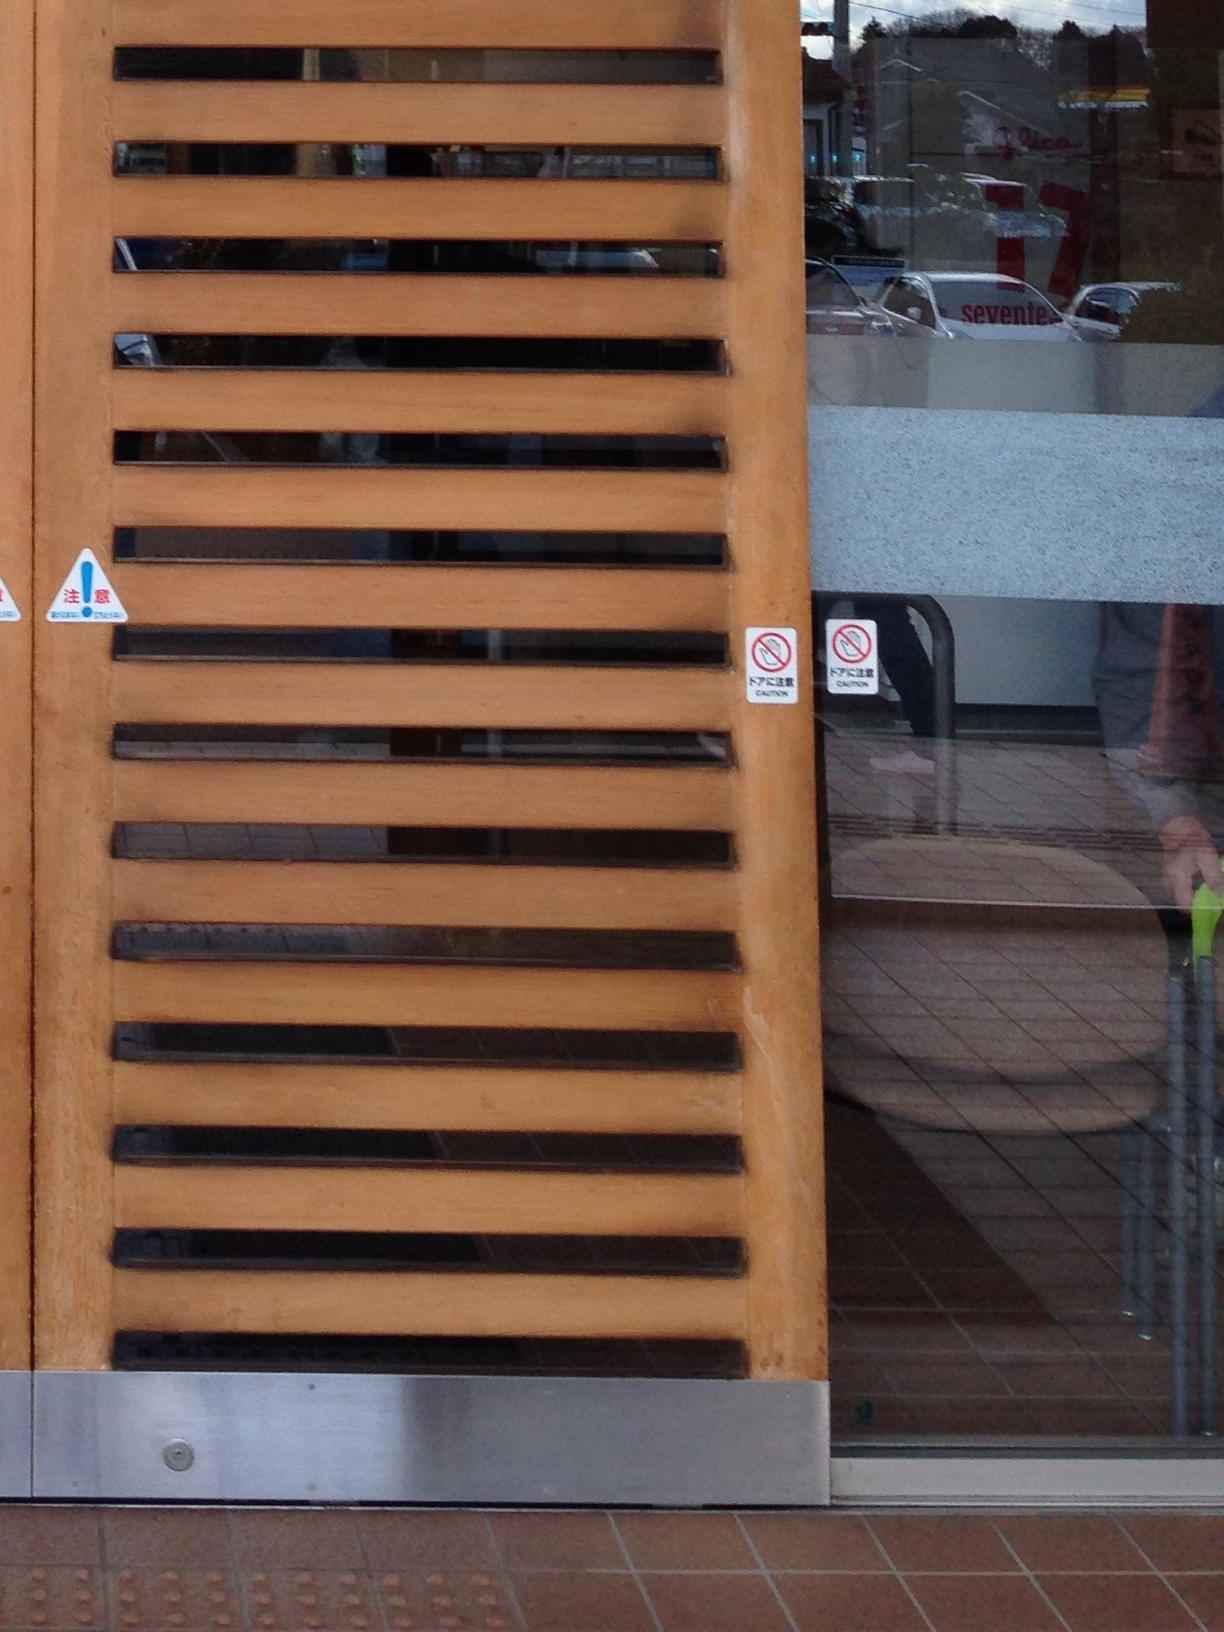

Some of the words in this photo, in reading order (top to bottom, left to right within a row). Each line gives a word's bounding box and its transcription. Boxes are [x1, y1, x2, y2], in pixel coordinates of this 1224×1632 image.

[830, 667, 874, 678] ドアに注意
[749, 676, 795, 688] ドアに注意
[836, 680, 869, 688] CAUTION
[755, 689, 789, 697] CAUTION
